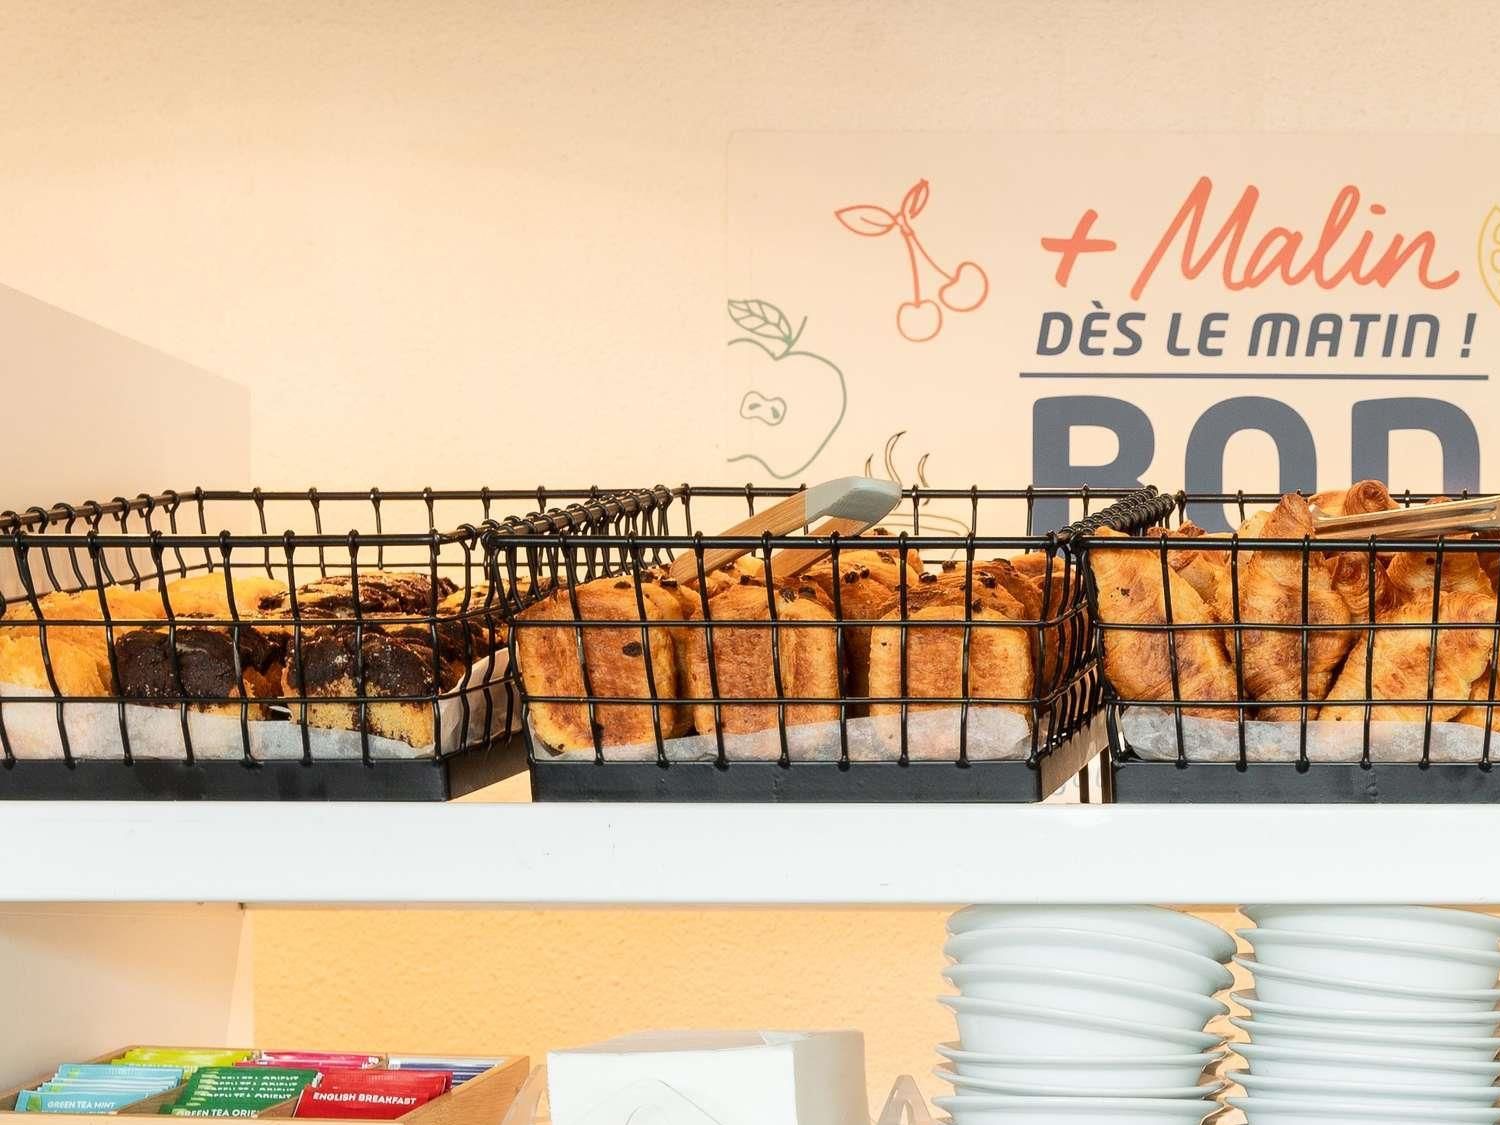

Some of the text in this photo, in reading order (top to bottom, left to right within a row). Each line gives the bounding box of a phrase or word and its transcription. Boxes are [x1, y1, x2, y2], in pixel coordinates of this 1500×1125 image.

[1130, 176, 1460, 300] Malin
[1036, 300, 1477, 358] DÈS LE MATIN !
[47, 1100, 115, 1110] GREEN TEA MINT
[313, 1091, 417, 1105] ENGLISH BREAKFAST
[211, 1109, 229, 1117] TEA
